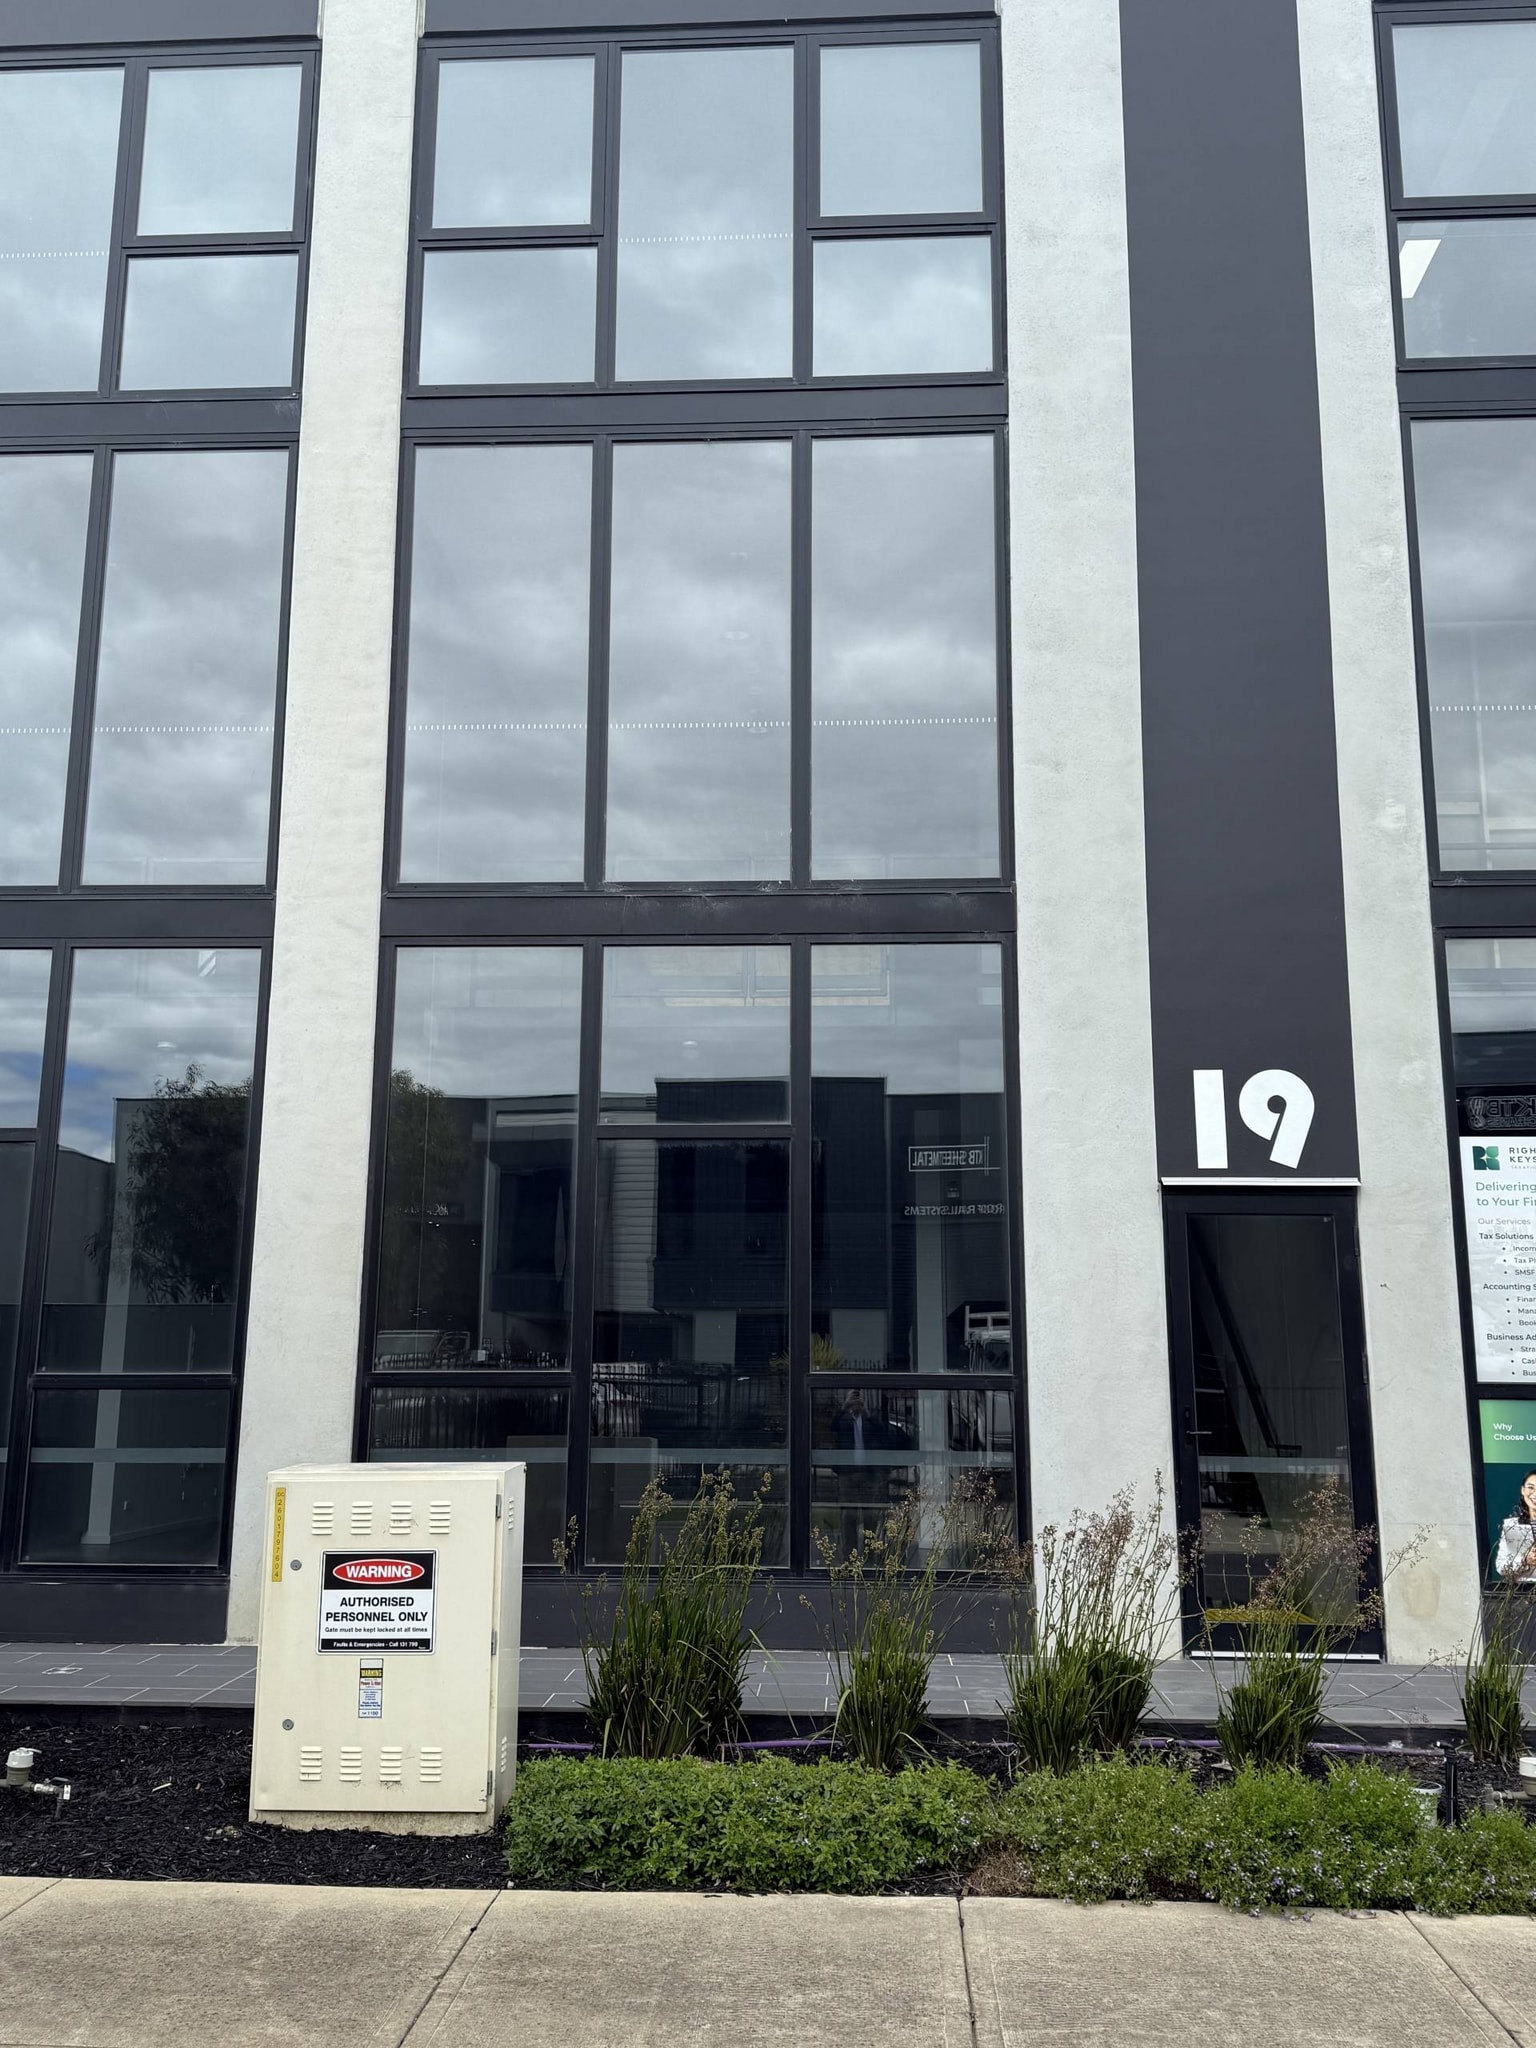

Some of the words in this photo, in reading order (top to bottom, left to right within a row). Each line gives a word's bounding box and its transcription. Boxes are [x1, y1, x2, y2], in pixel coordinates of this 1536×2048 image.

[1193, 1069, 1315, 1169] 19
[1476, 1182, 1536, 1193] Delivering
[1476, 1198, 1489, 1206] to
[1492, 1197, 1519, 1206] Your
[1496, 1217, 1531, 1225] Services
[1495, 1232, 1534, 1240] Solutions
[1483, 1283, 1531, 1292] Accounting
[1493, 1423, 1512, 1431] Why
[1493, 1433, 1524, 1441] Choose
[346, 1565, 412, 1578] WARNING
[340, 1597, 414, 1607] AUTHORISED
[325, 1612, 395, 1622] PERSONNEL
[398, 1611, 428, 1622] ONLY
